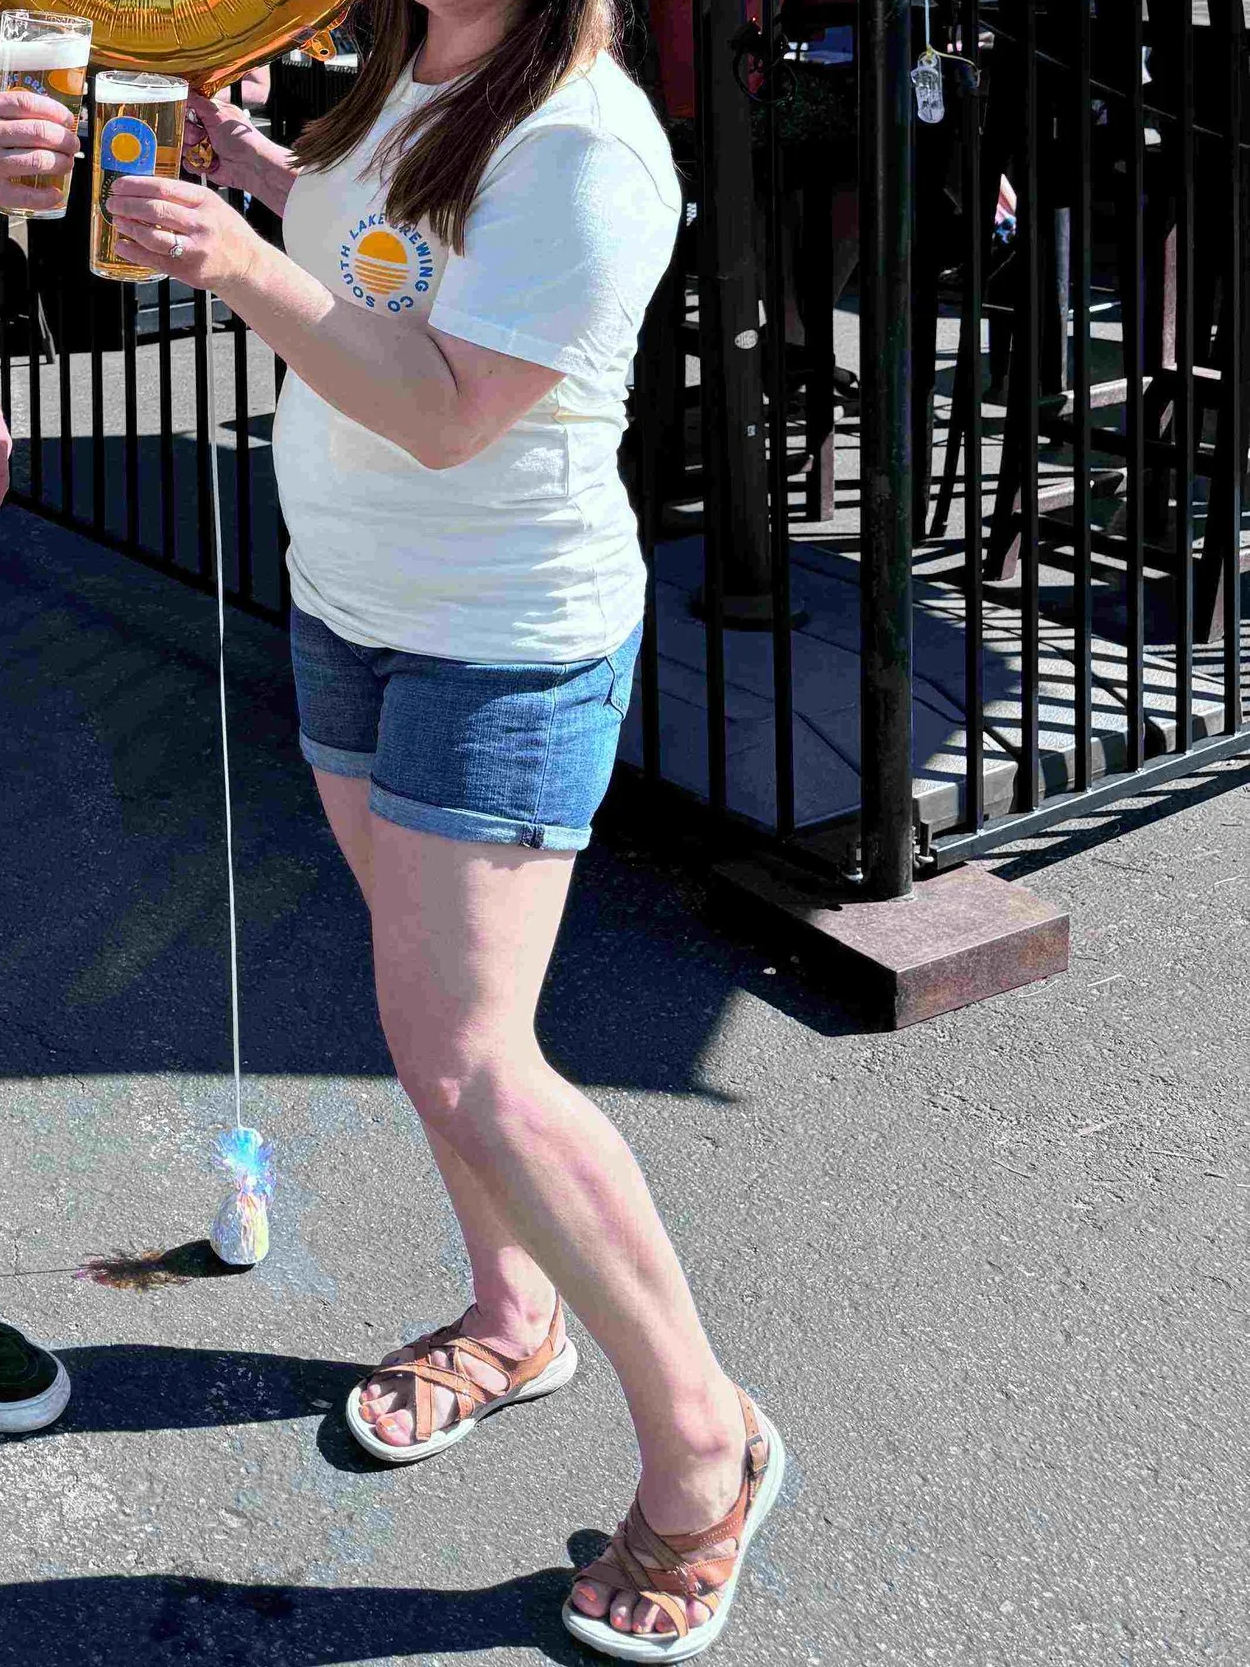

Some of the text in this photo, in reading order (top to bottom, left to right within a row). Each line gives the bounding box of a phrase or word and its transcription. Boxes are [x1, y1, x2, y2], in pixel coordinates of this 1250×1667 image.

[350, 213, 386, 240] LAKE
[340, 245, 376, 308] SOUTH
[387, 295, 414, 313] CO
